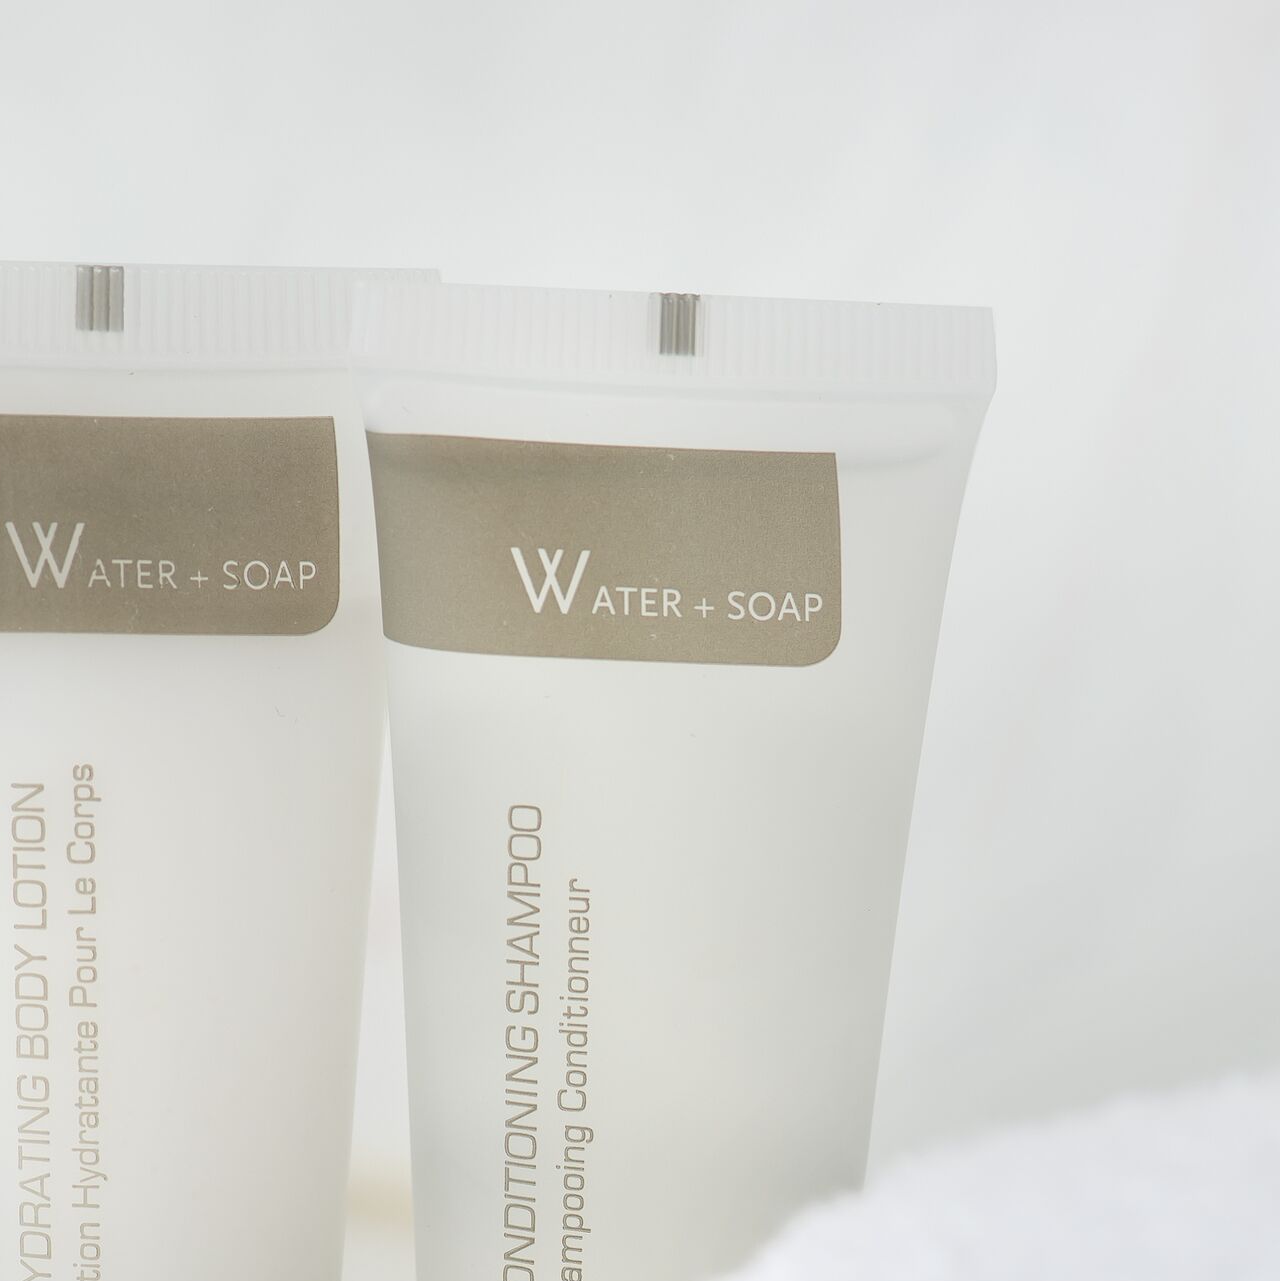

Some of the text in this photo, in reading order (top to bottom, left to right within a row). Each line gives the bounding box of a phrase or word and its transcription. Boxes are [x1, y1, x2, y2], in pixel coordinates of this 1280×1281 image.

[190, 571, 209, 588] +
[222, 560, 317, 590] SOAP
[693, 598, 715, 619] +
[726, 590, 824, 623] SOAP
[10, 782, 48, 930] LOTION
[66, 763, 102, 865] Corps
[67, 876, 97, 915] Le
[505, 804, 543, 1016] SHAMPOO
[13, 943, 50, 1061] BODY
[67, 926, 98, 1008] Pour
[556, 878, 591, 1113] Conditionneur
[70, 1020, 108, 1209] Hydratante
